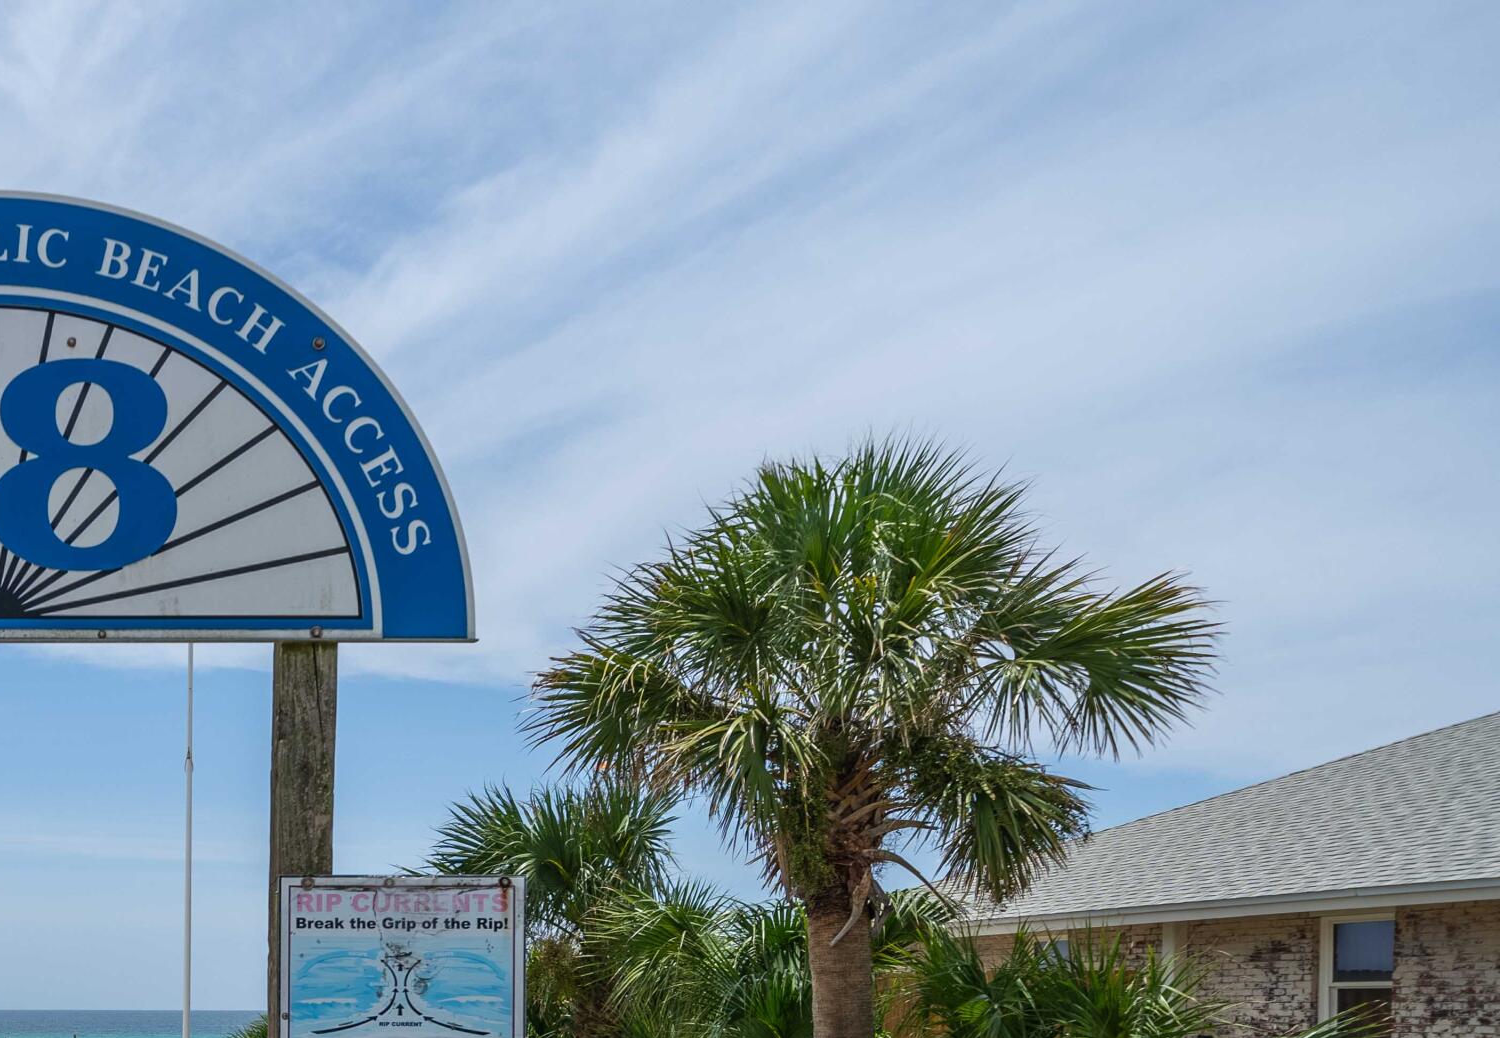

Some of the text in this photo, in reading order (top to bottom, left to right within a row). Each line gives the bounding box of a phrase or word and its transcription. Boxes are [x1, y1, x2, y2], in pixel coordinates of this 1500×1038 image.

[97, 236, 284, 355] BEACH
[287, 356, 431, 556] ACCESS
[296, 893, 508, 912] RIP CURRENTS
[296, 917, 508, 932] Break the Grip of the Rip!
